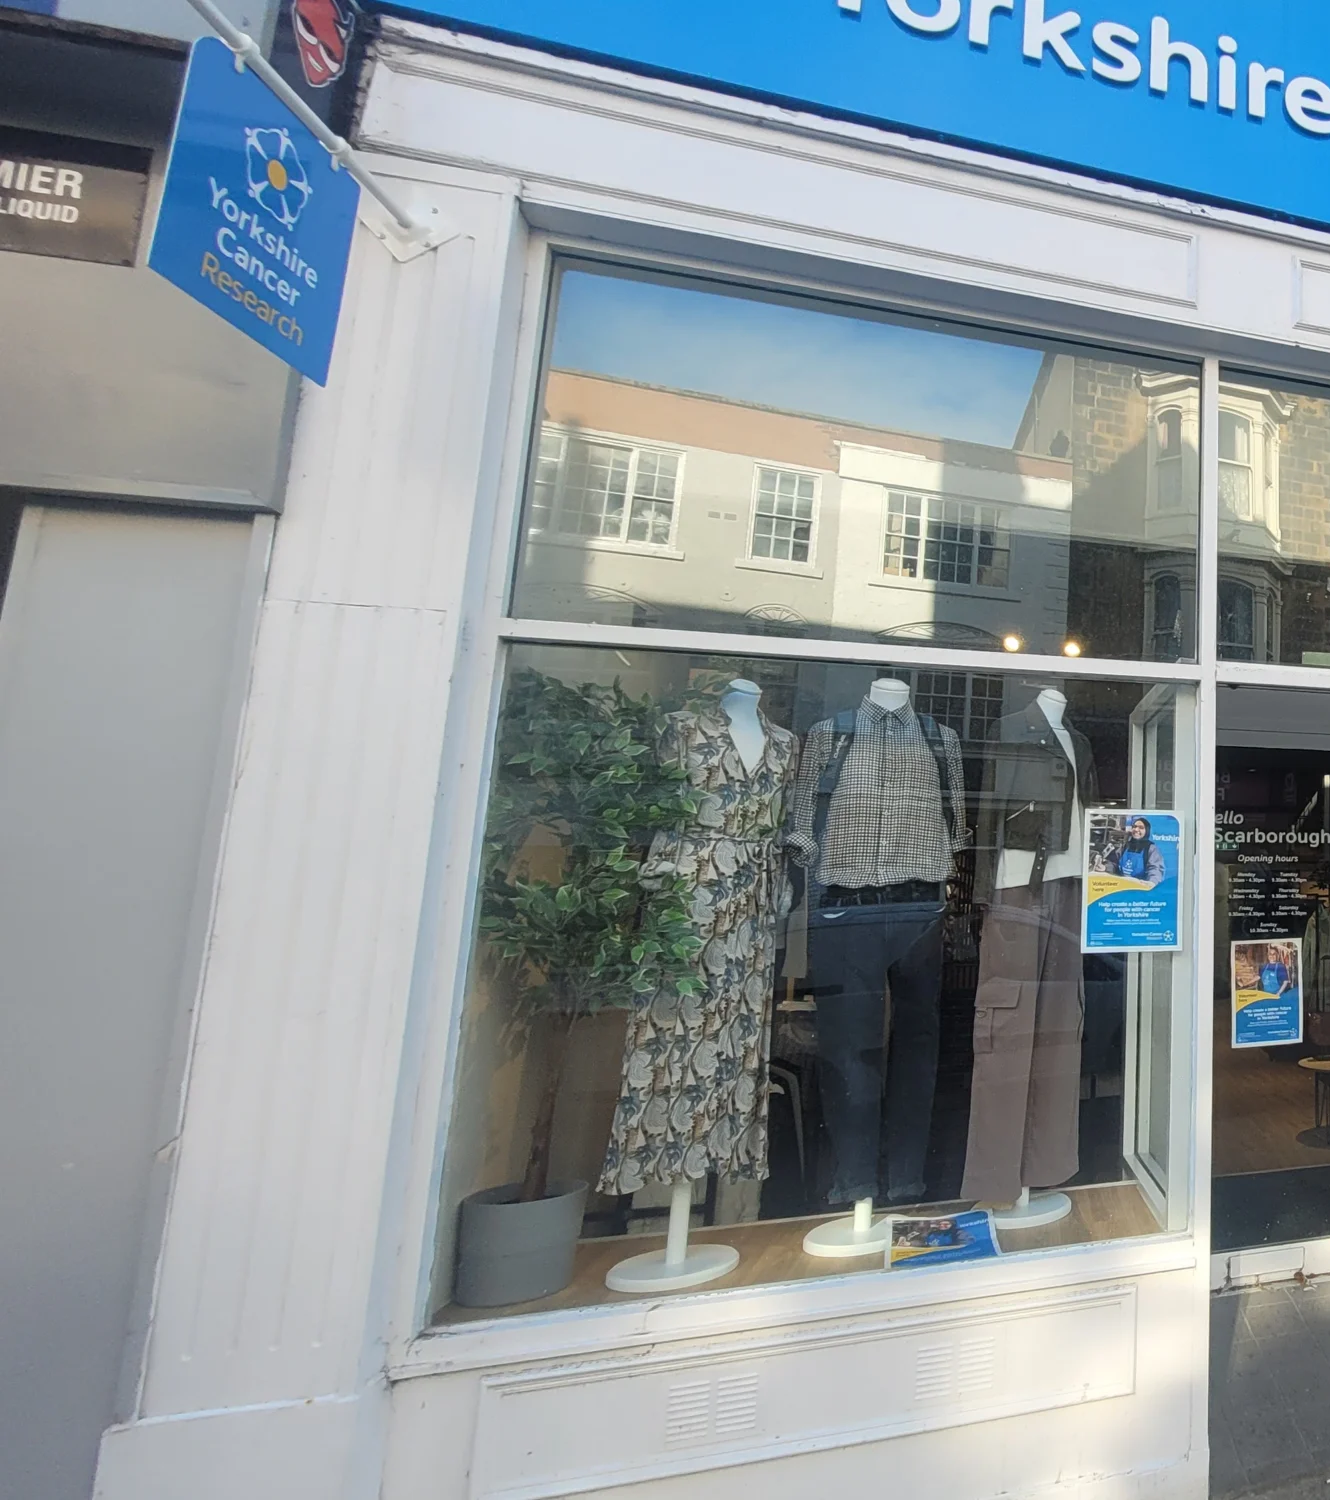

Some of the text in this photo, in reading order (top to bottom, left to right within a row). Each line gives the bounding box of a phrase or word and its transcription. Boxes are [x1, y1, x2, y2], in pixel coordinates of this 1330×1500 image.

[209, 176, 318, 289] Yorkshire
[217, 227, 301, 307] Cancer
[200, 251, 304, 346] Research
[1214, 828, 1330, 848] Scarborough
[1237, 854, 1274, 864] Opening
